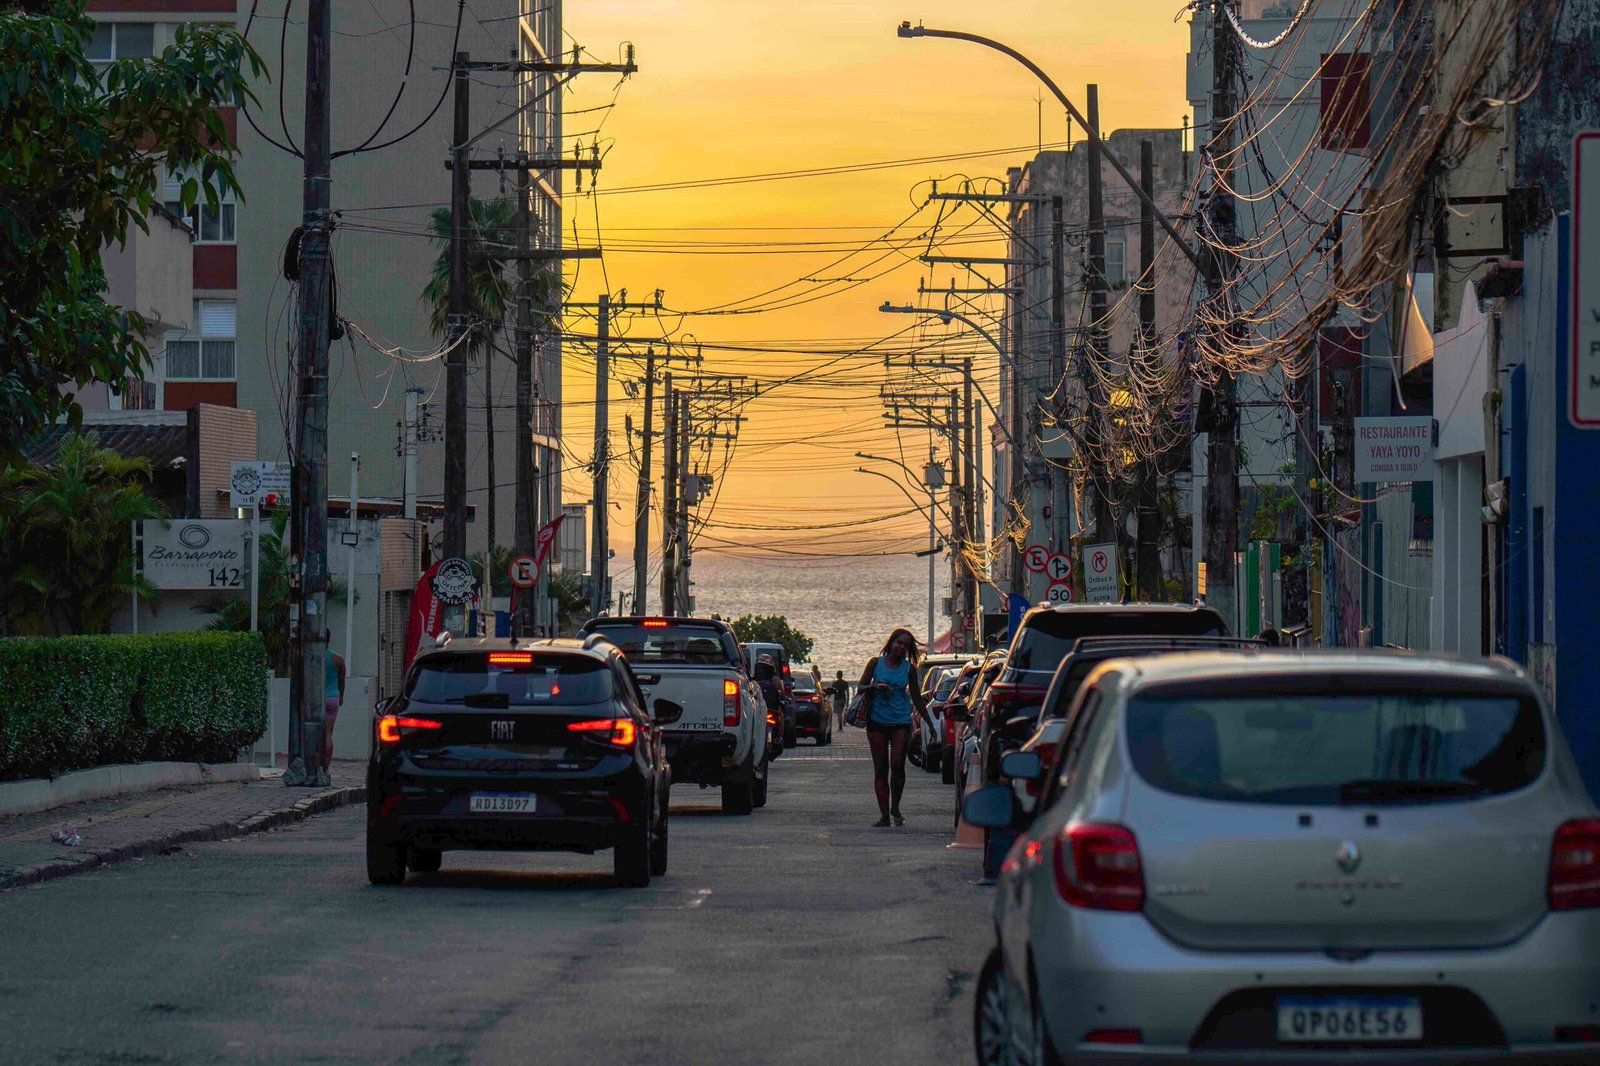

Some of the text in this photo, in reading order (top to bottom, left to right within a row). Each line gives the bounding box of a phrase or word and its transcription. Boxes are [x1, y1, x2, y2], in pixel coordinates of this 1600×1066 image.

[1360, 426, 1428, 439] RESTAURANTE
[1370, 445, 1420, 458] YAYA YOYO
[148, 545, 238, 562] Barraporto
[208, 567, 241, 587] 142
[442, 580, 469, 591] OFICINA
[1050, 589, 1070, 601] 30
[490, 720, 516, 740] FIAT
